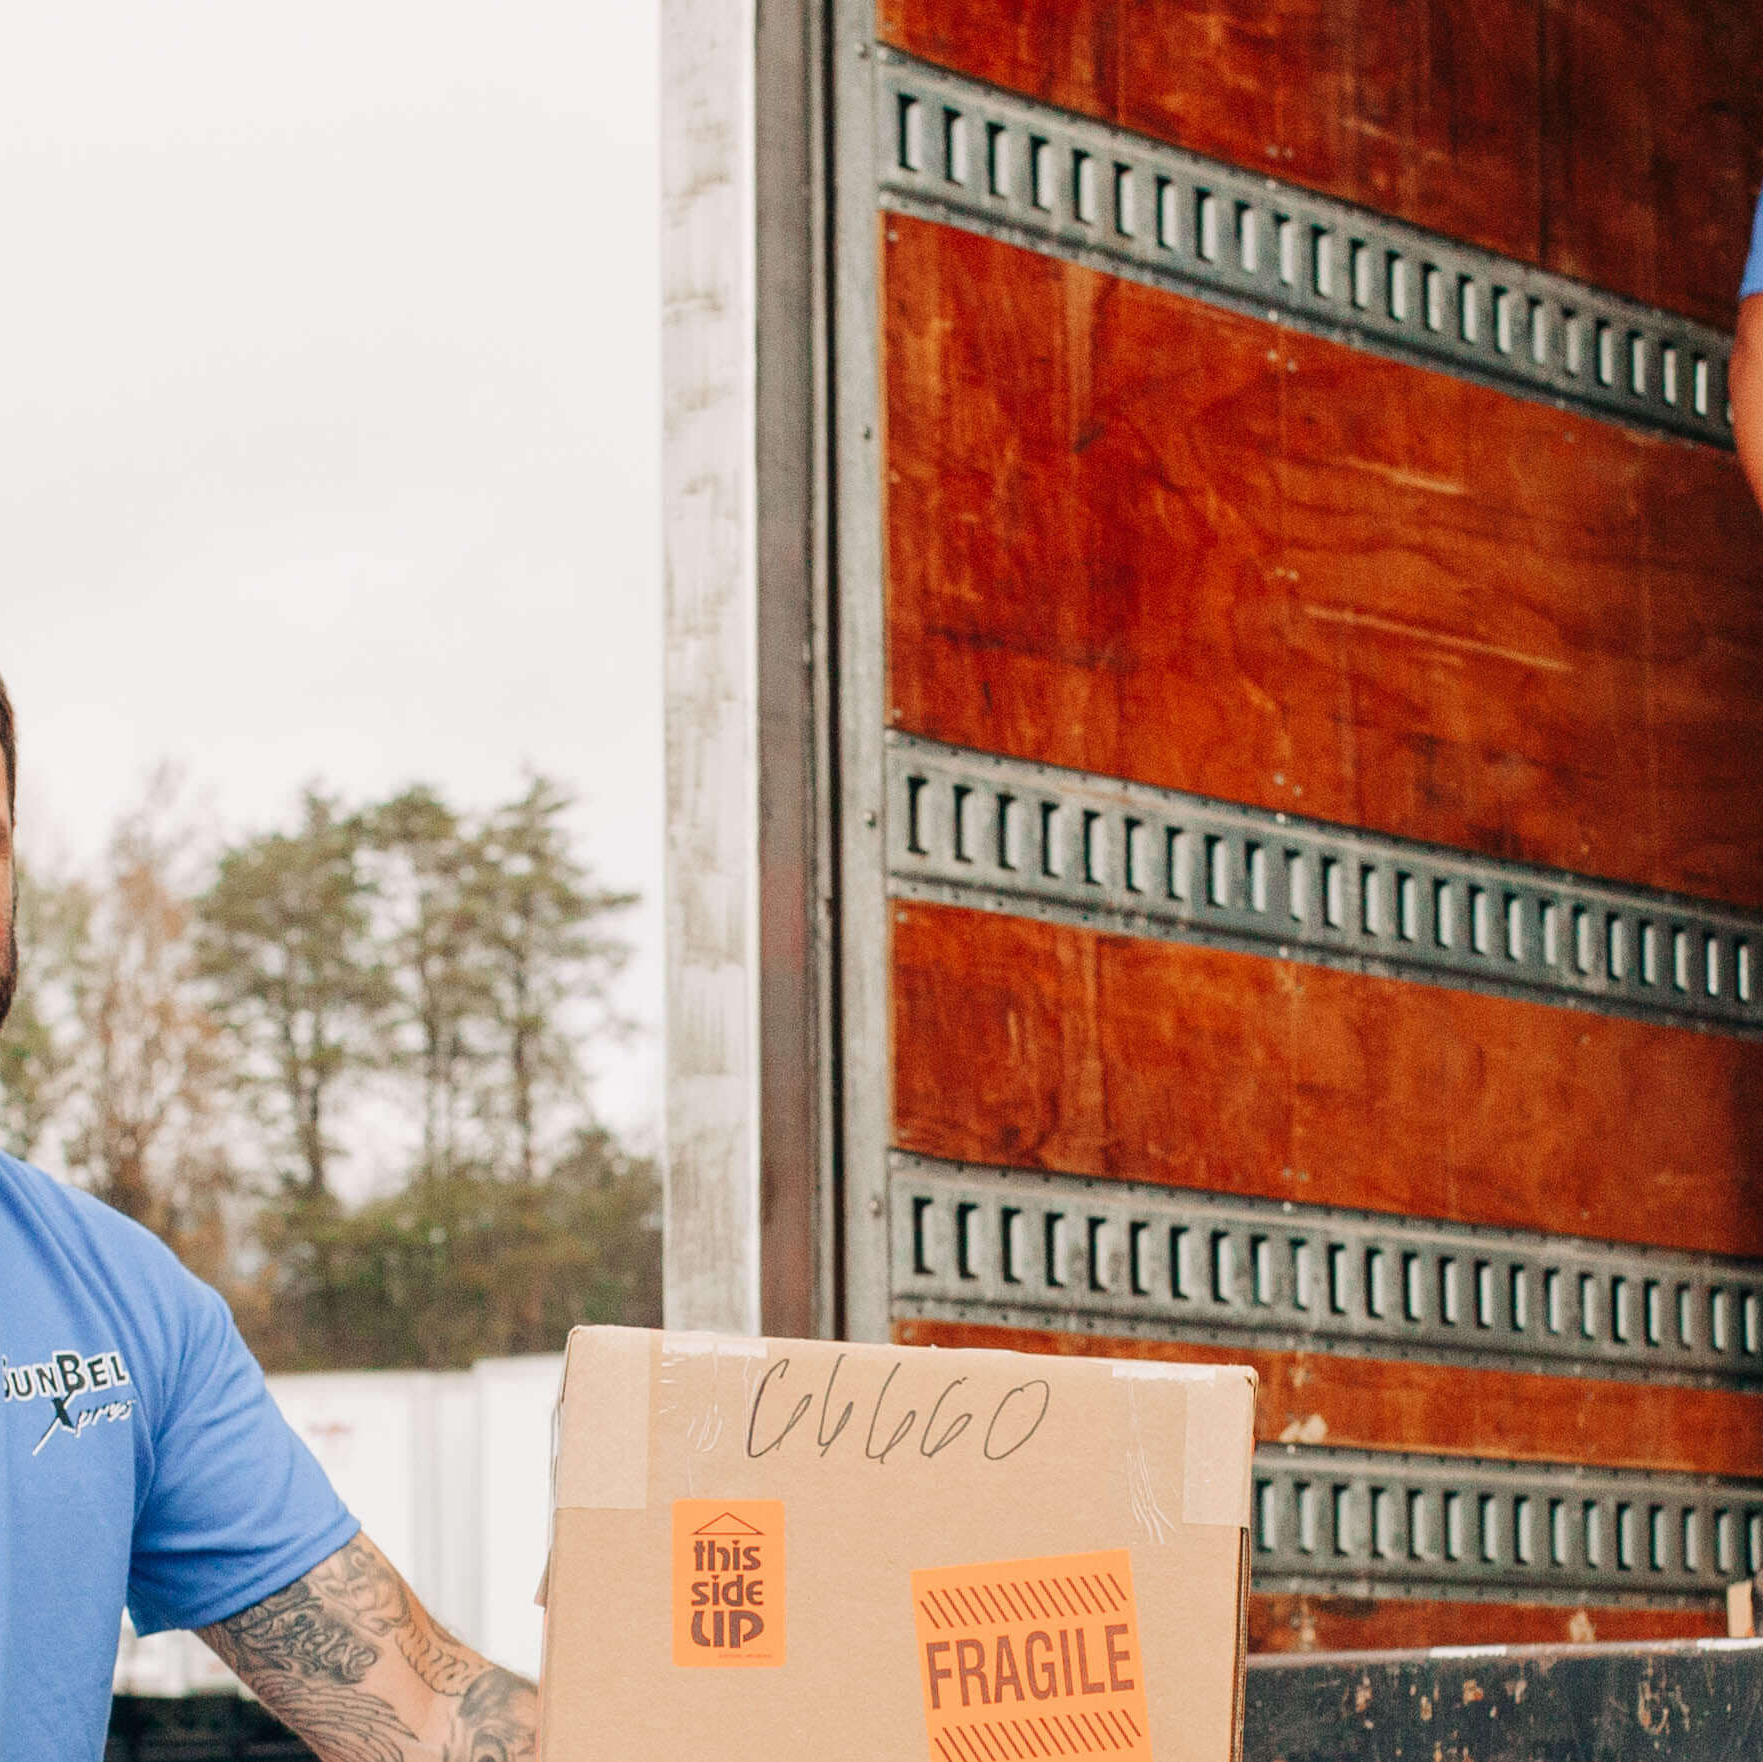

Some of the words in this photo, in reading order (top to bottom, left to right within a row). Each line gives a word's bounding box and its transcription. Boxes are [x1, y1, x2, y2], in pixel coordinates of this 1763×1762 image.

[693, 1539, 762, 1572] this
[690, 1574, 764, 1608] side
[690, 1609, 766, 1649] UP
[925, 1623, 1135, 1710] FRAGILE
